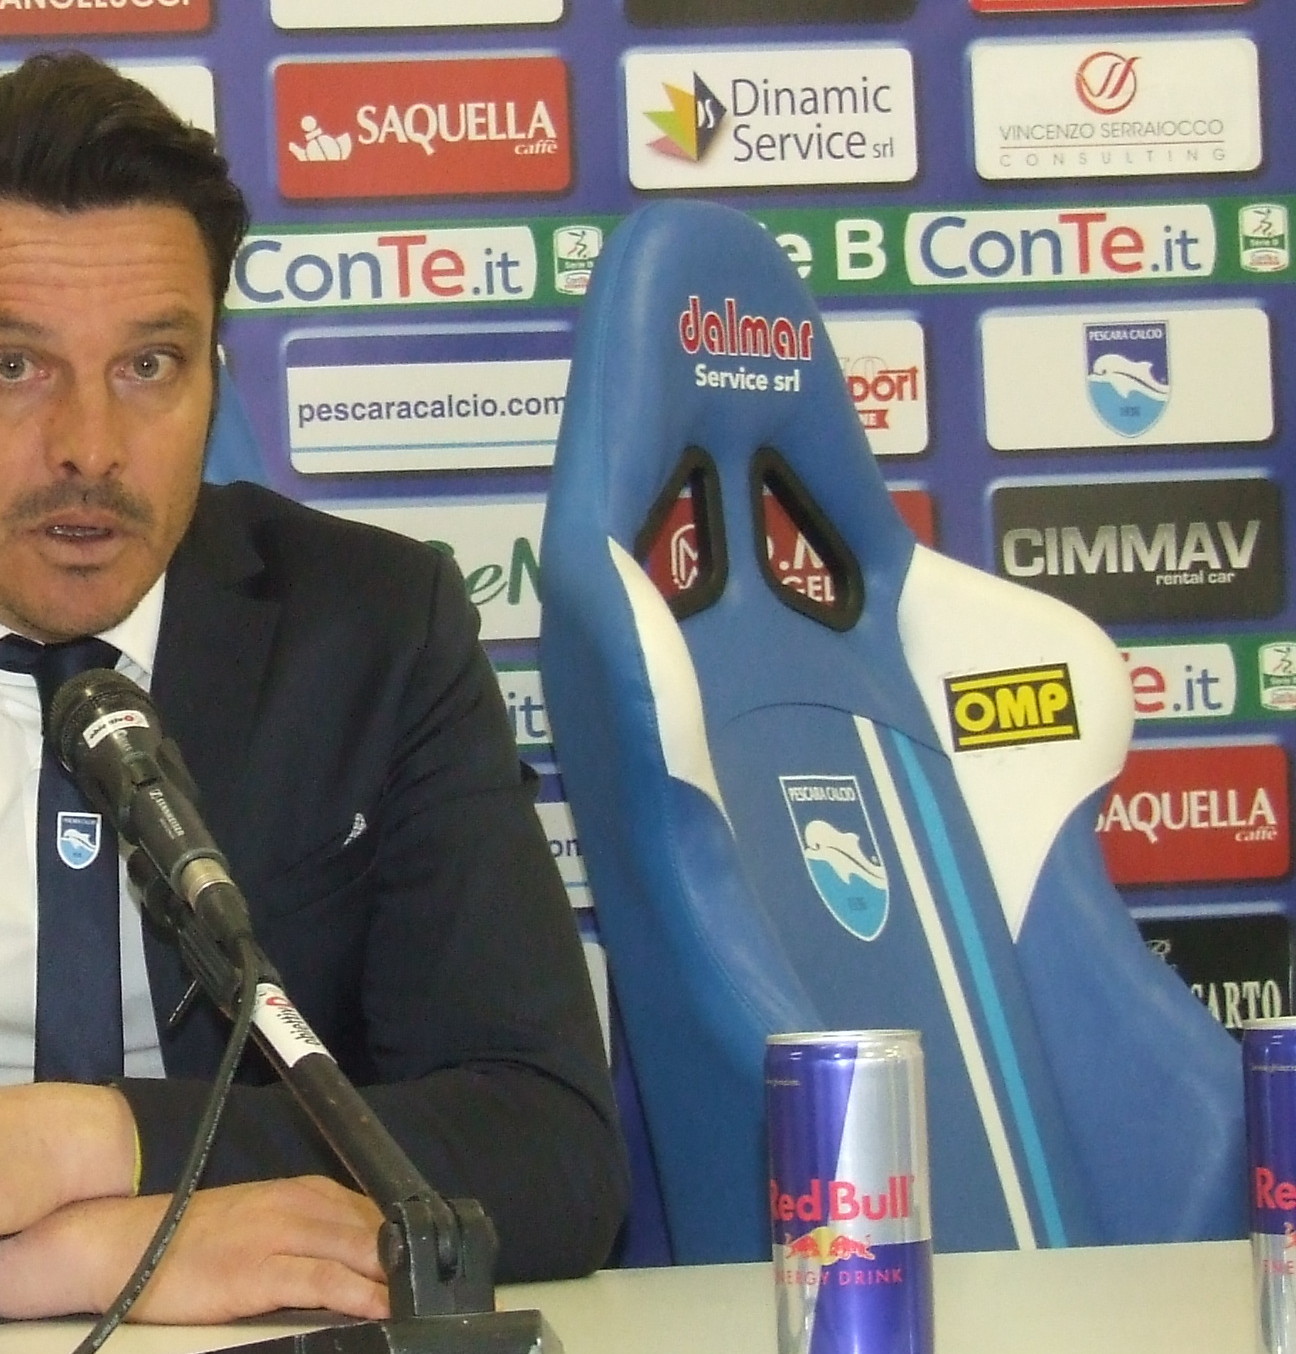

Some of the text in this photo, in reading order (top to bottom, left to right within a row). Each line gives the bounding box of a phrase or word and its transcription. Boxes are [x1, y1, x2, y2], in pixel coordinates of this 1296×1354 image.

[731, 76, 892, 117] Dinamic
[357, 101, 557, 156] SAQUELLA
[733, 123, 895, 163] Service srl
[999, 119, 1225, 141] VINCENZO SERRAIOCCO
[1000, 147, 1227, 169] CONSULTING
[835, 219, 887, 281] B
[920, 212, 1202, 279] ConTe.it
[234, 235, 523, 303] ConTe.it
[679, 296, 815, 362] dalmar
[695, 364, 800, 393] Service srl
[299, 392, 567, 428] pescaracalcio.com
[1004, 520, 1261, 579] CIMMAV
[1155, 570, 1235, 586] rental car
[954, 683, 1070, 733] OMP
[828, 1176, 908, 1221] Bull
[1255, 1166, 1296, 1211] Re
[838, 1268, 903, 1286] DRINK
